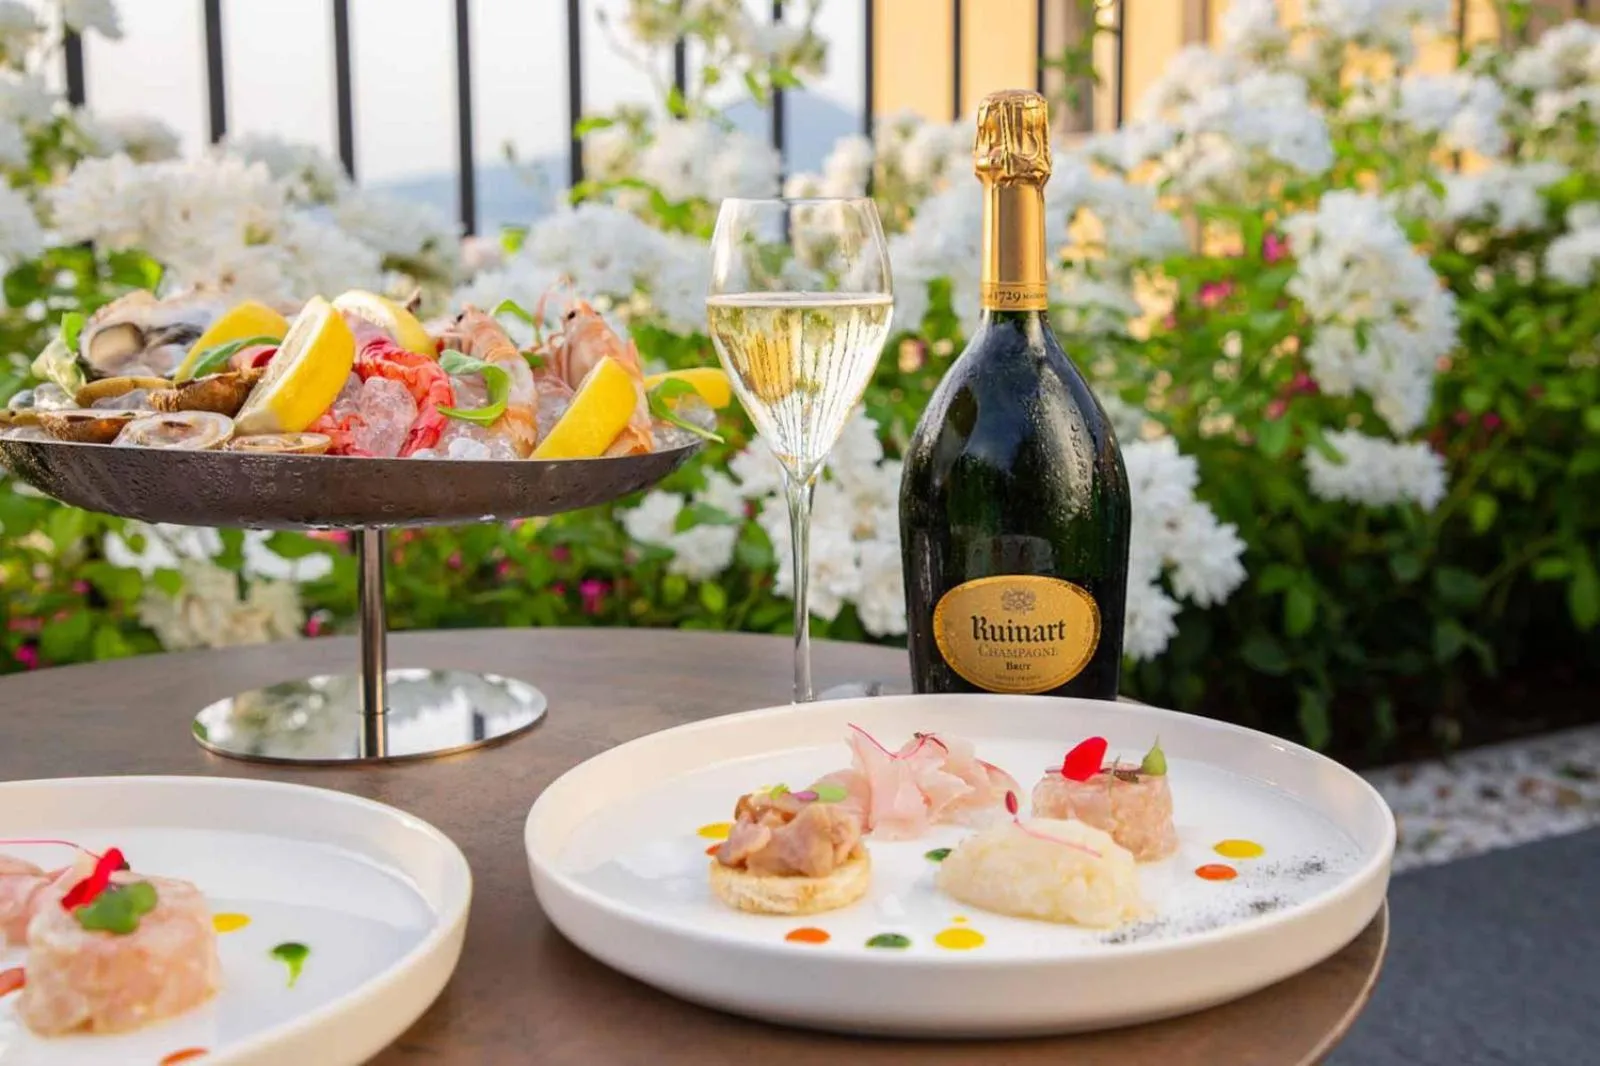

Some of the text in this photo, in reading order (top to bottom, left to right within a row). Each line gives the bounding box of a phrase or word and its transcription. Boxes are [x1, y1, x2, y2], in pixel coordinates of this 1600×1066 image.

[994, 291, 1021, 304] 1729
[970, 615, 1066, 643] Ruinart
[978, 644, 1058, 658] CHAMPAGNE
